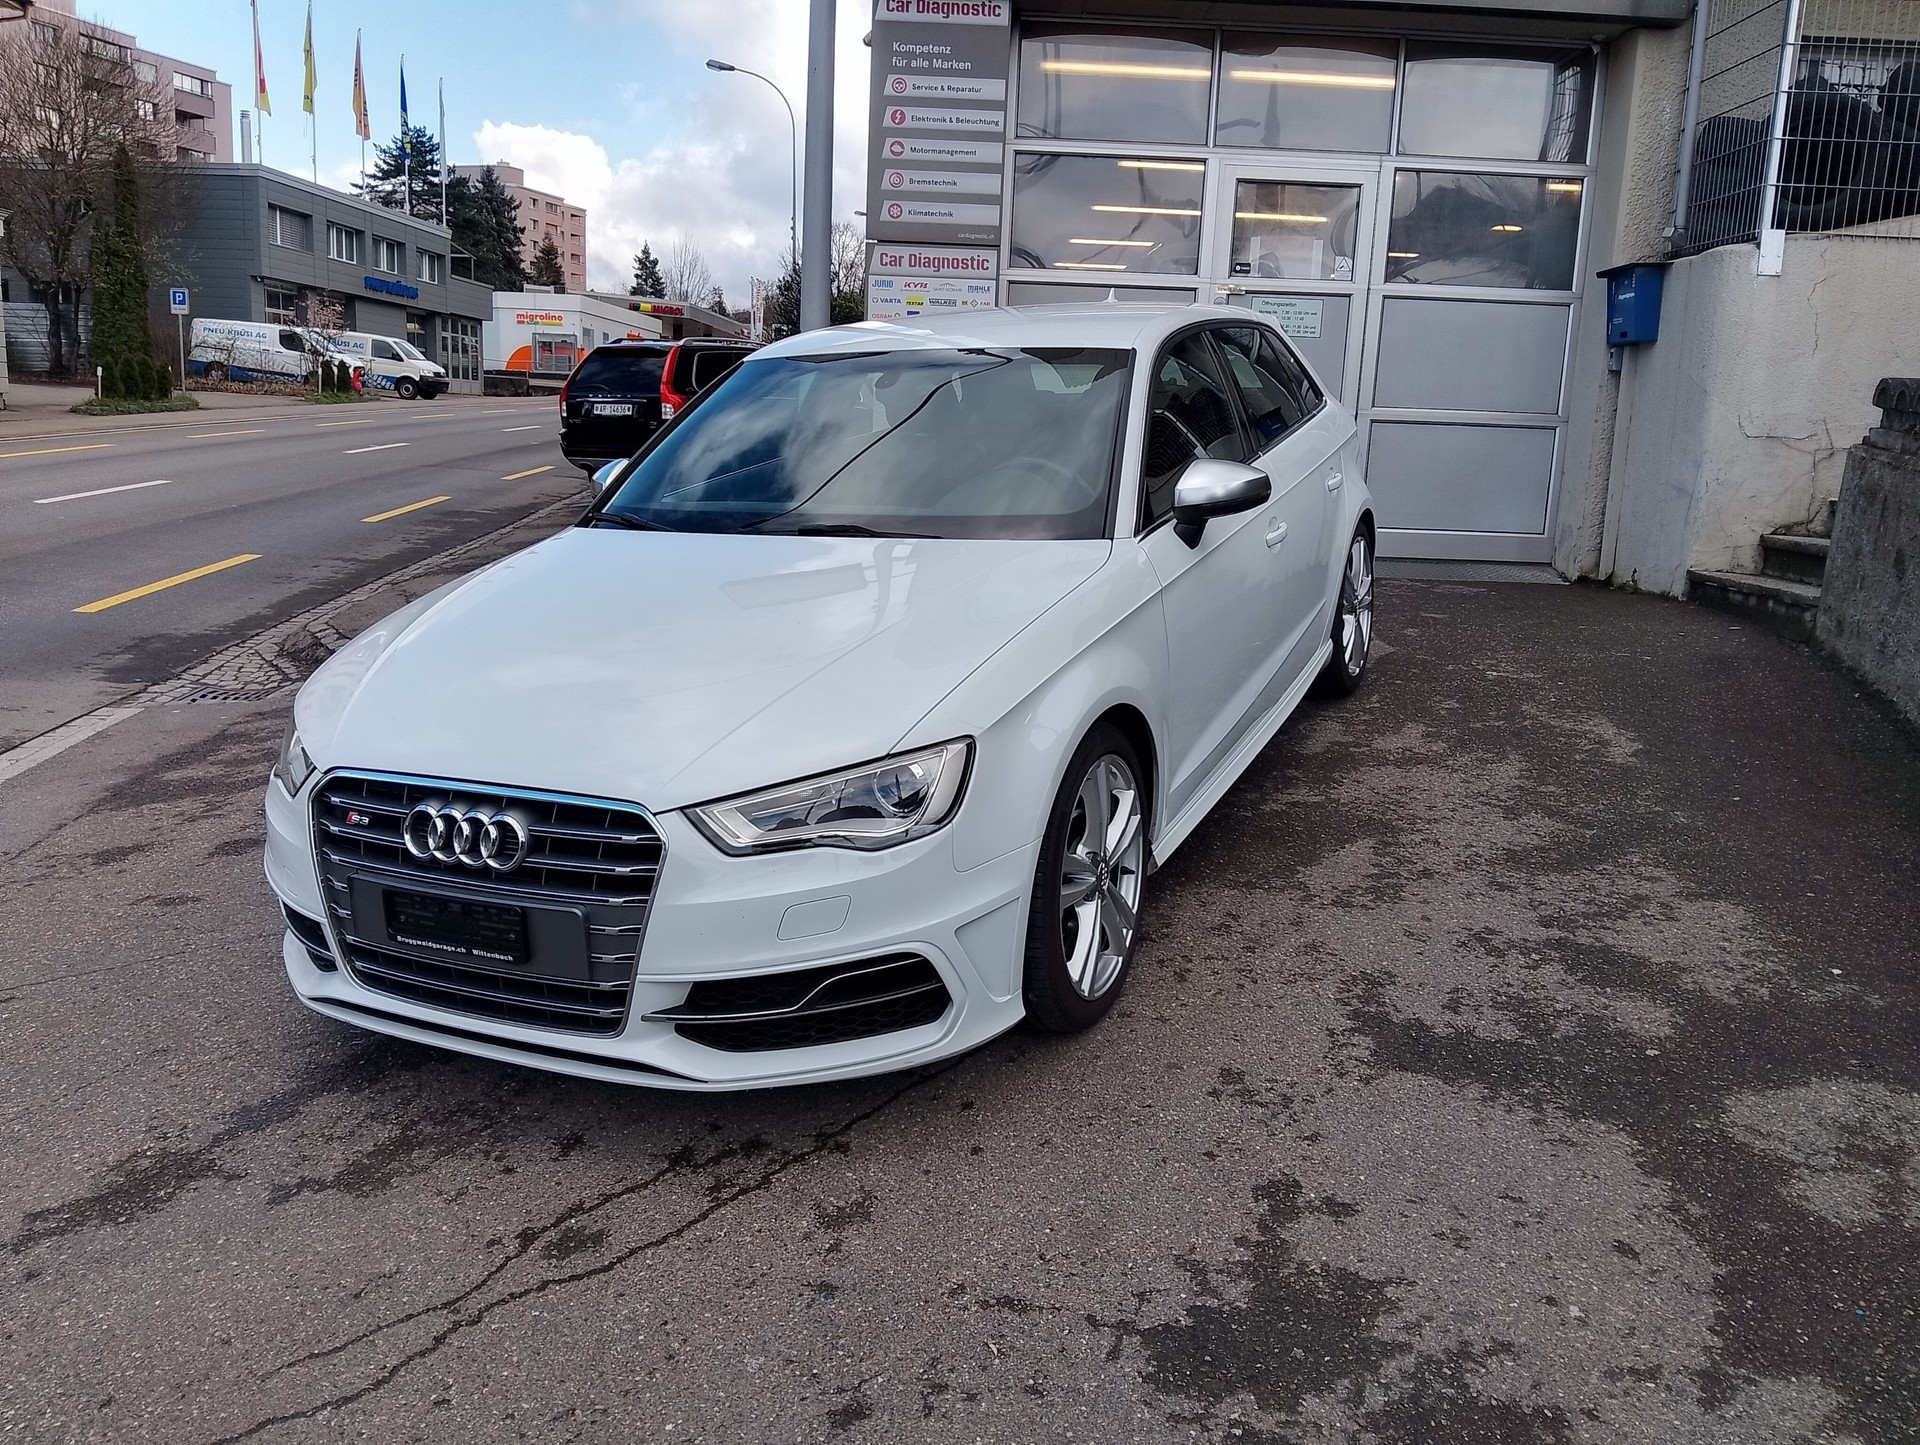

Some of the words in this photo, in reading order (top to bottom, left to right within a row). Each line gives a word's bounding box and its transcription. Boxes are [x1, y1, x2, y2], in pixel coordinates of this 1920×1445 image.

[886, 0, 912, 13] Car
[916, 0, 1002, 18] Diagnostic
[892, 41, 952, 55] Kompetenz
[892, 56, 908, 67] für
[910, 57, 930, 68] alle
[932, 58, 972, 70] Marken
[911, 83, 939, 92] Service
[946, 84, 982, 94] Reparatur
[911, 114, 948, 124] Elektronik
[955, 116, 1000, 127] Beleuchtung
[909, 146, 977, 157] Motormanagement
[908, 177, 958, 187] Bremstechnik
[907, 208, 954, 218] Klimatechnik
[879, 252, 905, 268] Car
[908, 253, 990, 273] Diagnostic
[871, 279, 894, 289] JURID
[175, 292, 184, 304] P
[516, 311, 564, 322] migrolino
[202, 326, 225, 335] PNEU
[255, 331, 267, 339] AG
[352, 341, 365, 350] AG
[351, 814, 370, 826] S3
[396, 935, 467, 954] Bruggwaldgarage.ch
[471, 948, 514, 962] Wittenbach
